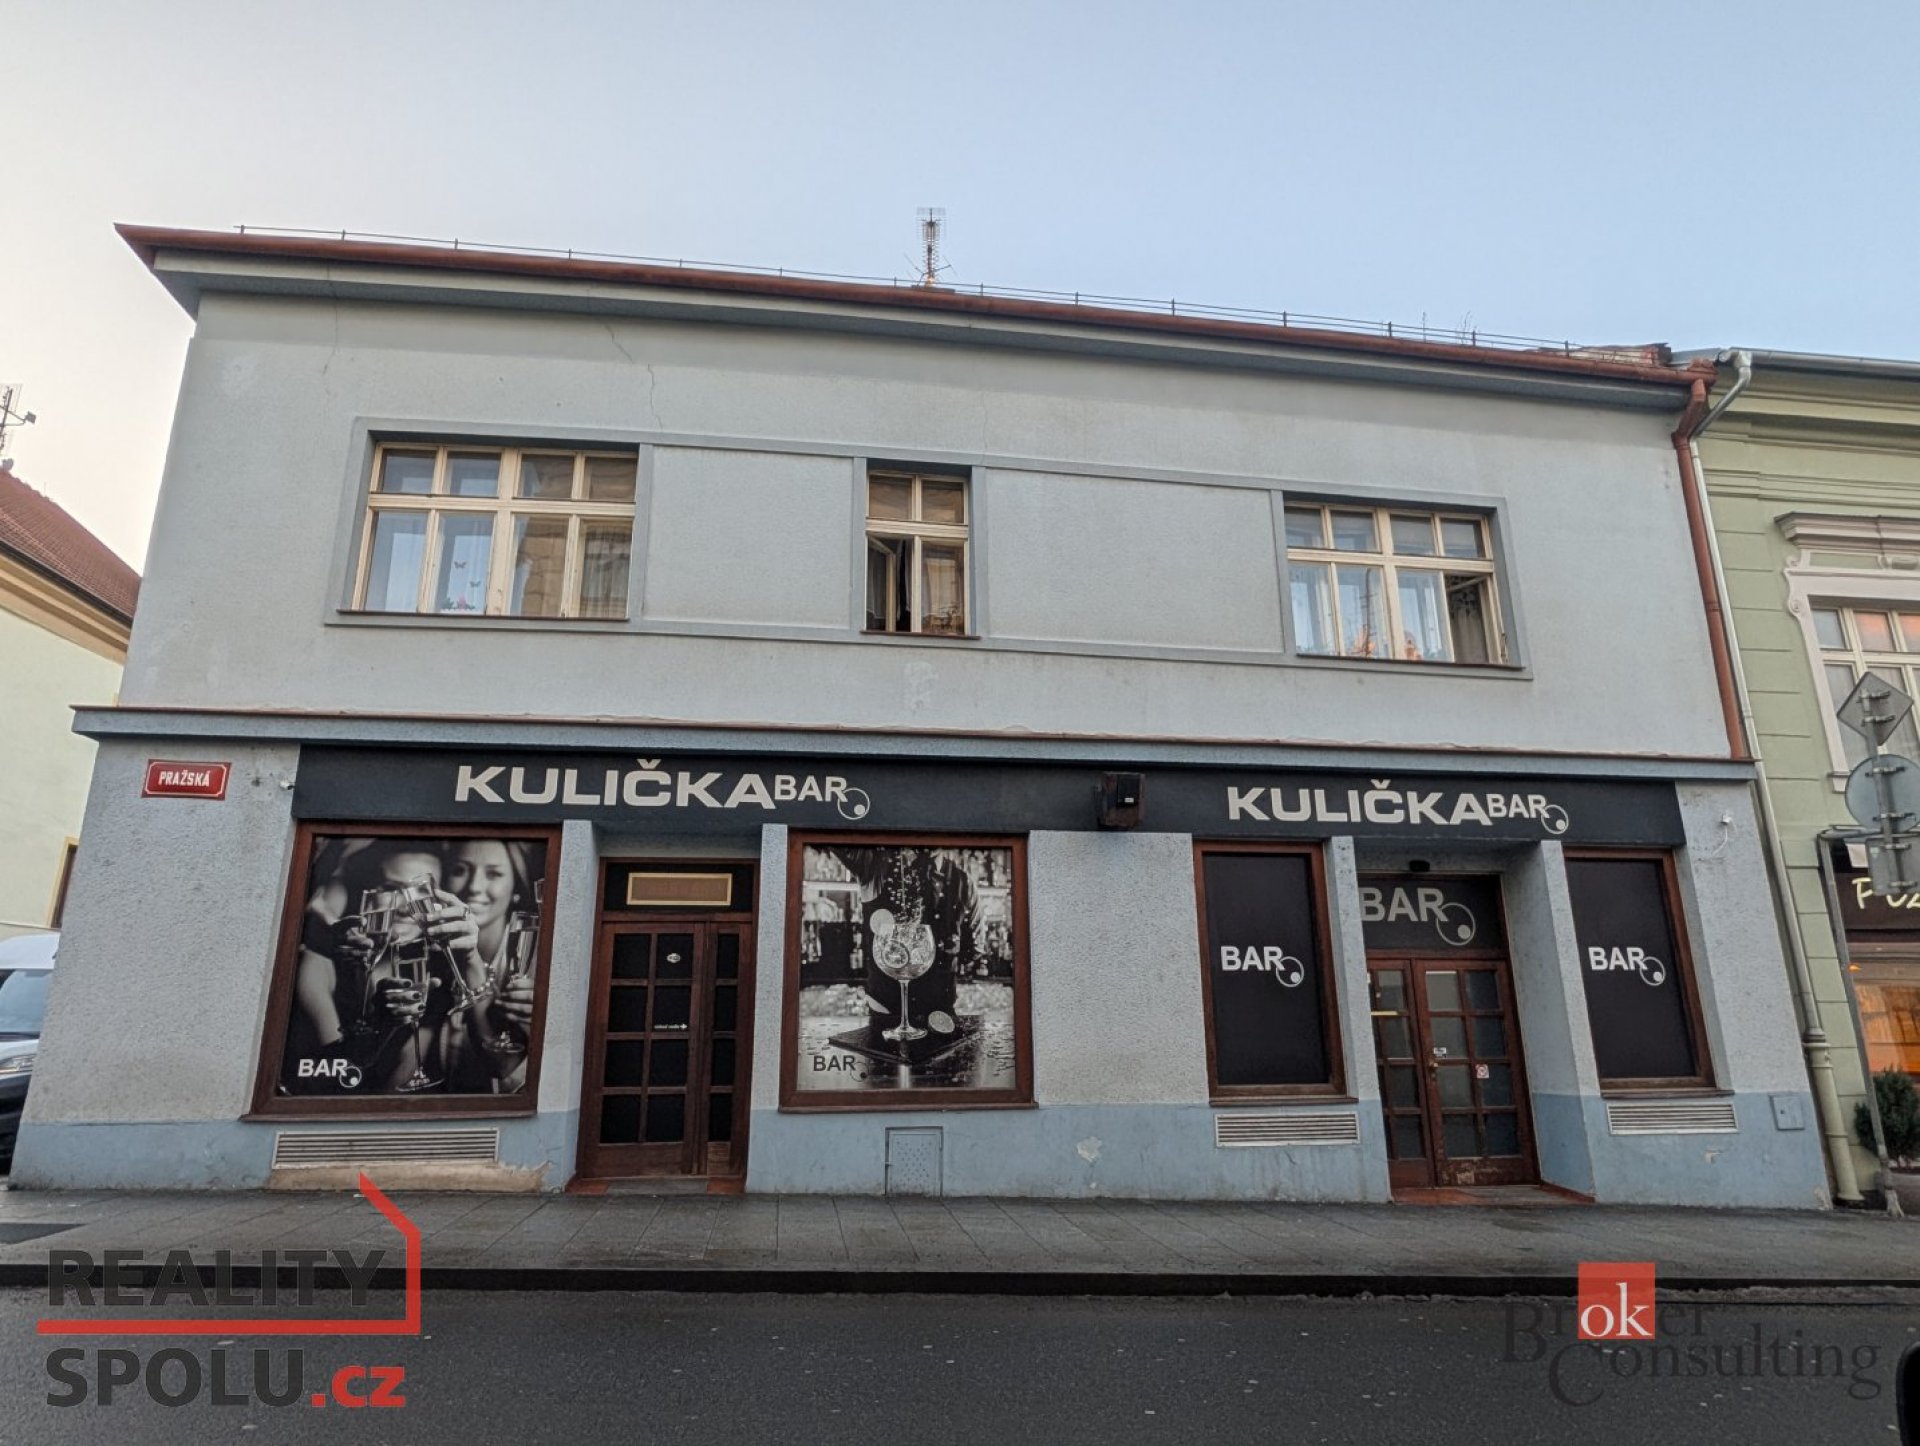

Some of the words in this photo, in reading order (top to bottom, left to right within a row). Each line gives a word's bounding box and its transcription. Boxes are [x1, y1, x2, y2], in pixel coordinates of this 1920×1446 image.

[158, 769, 211, 787] PRAŽSKÁ
[774, 774, 848, 803] BAR
[1486, 793, 1550, 818] BAR
[1358, 887, 1448, 922] BAR
[1220, 945, 1286, 971] BAR
[1588, 946, 1648, 971] BAR
[297, 1058, 348, 1077] BAR
[813, 1054, 856, 1072] BAR
